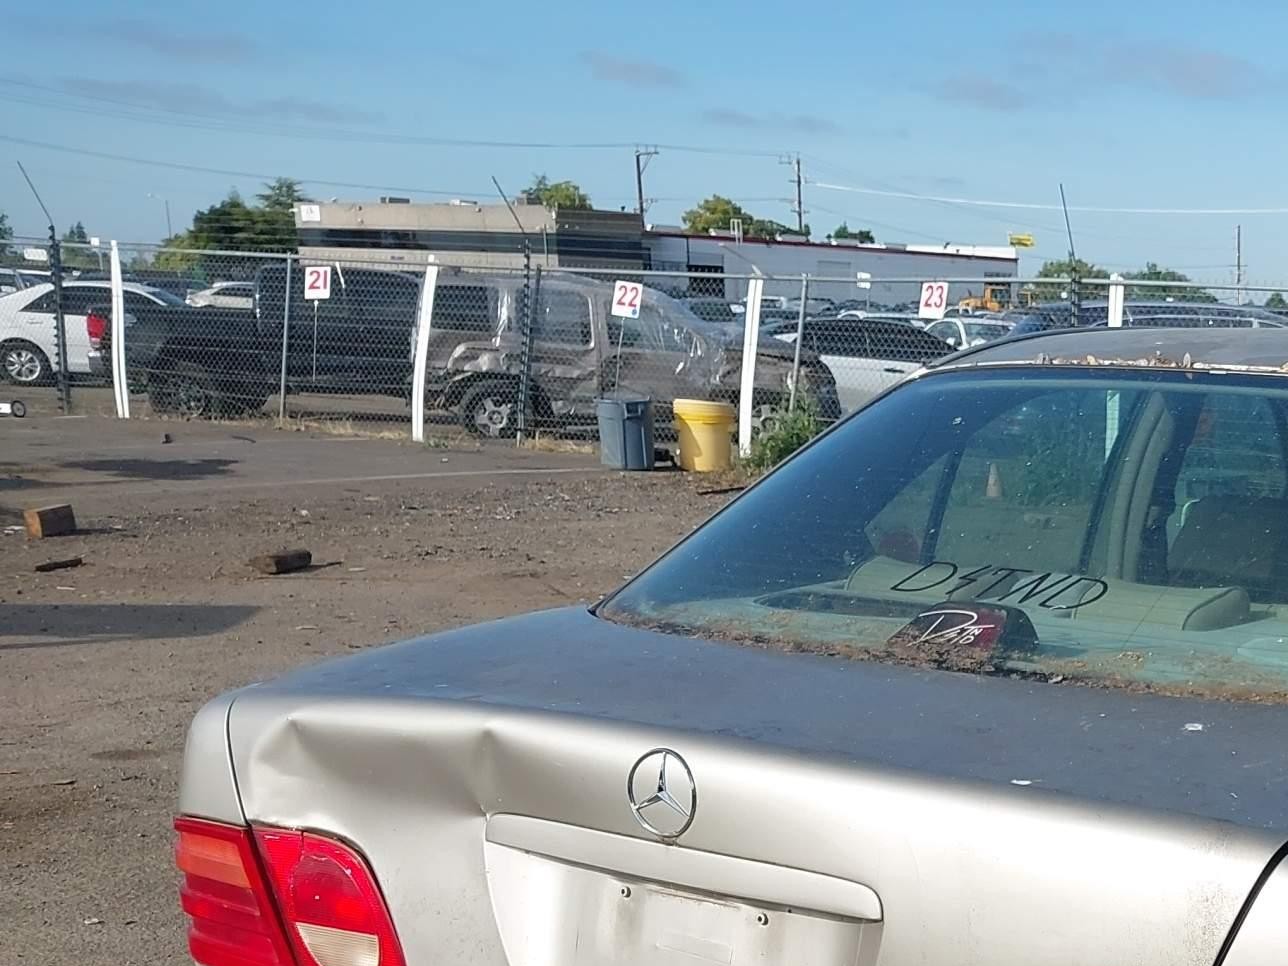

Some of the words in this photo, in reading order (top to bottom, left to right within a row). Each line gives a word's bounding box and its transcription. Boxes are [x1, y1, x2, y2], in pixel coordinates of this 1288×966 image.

[308, 270, 327, 290] 21
[616, 284, 639, 308] 22
[923, 285, 944, 308] 23
